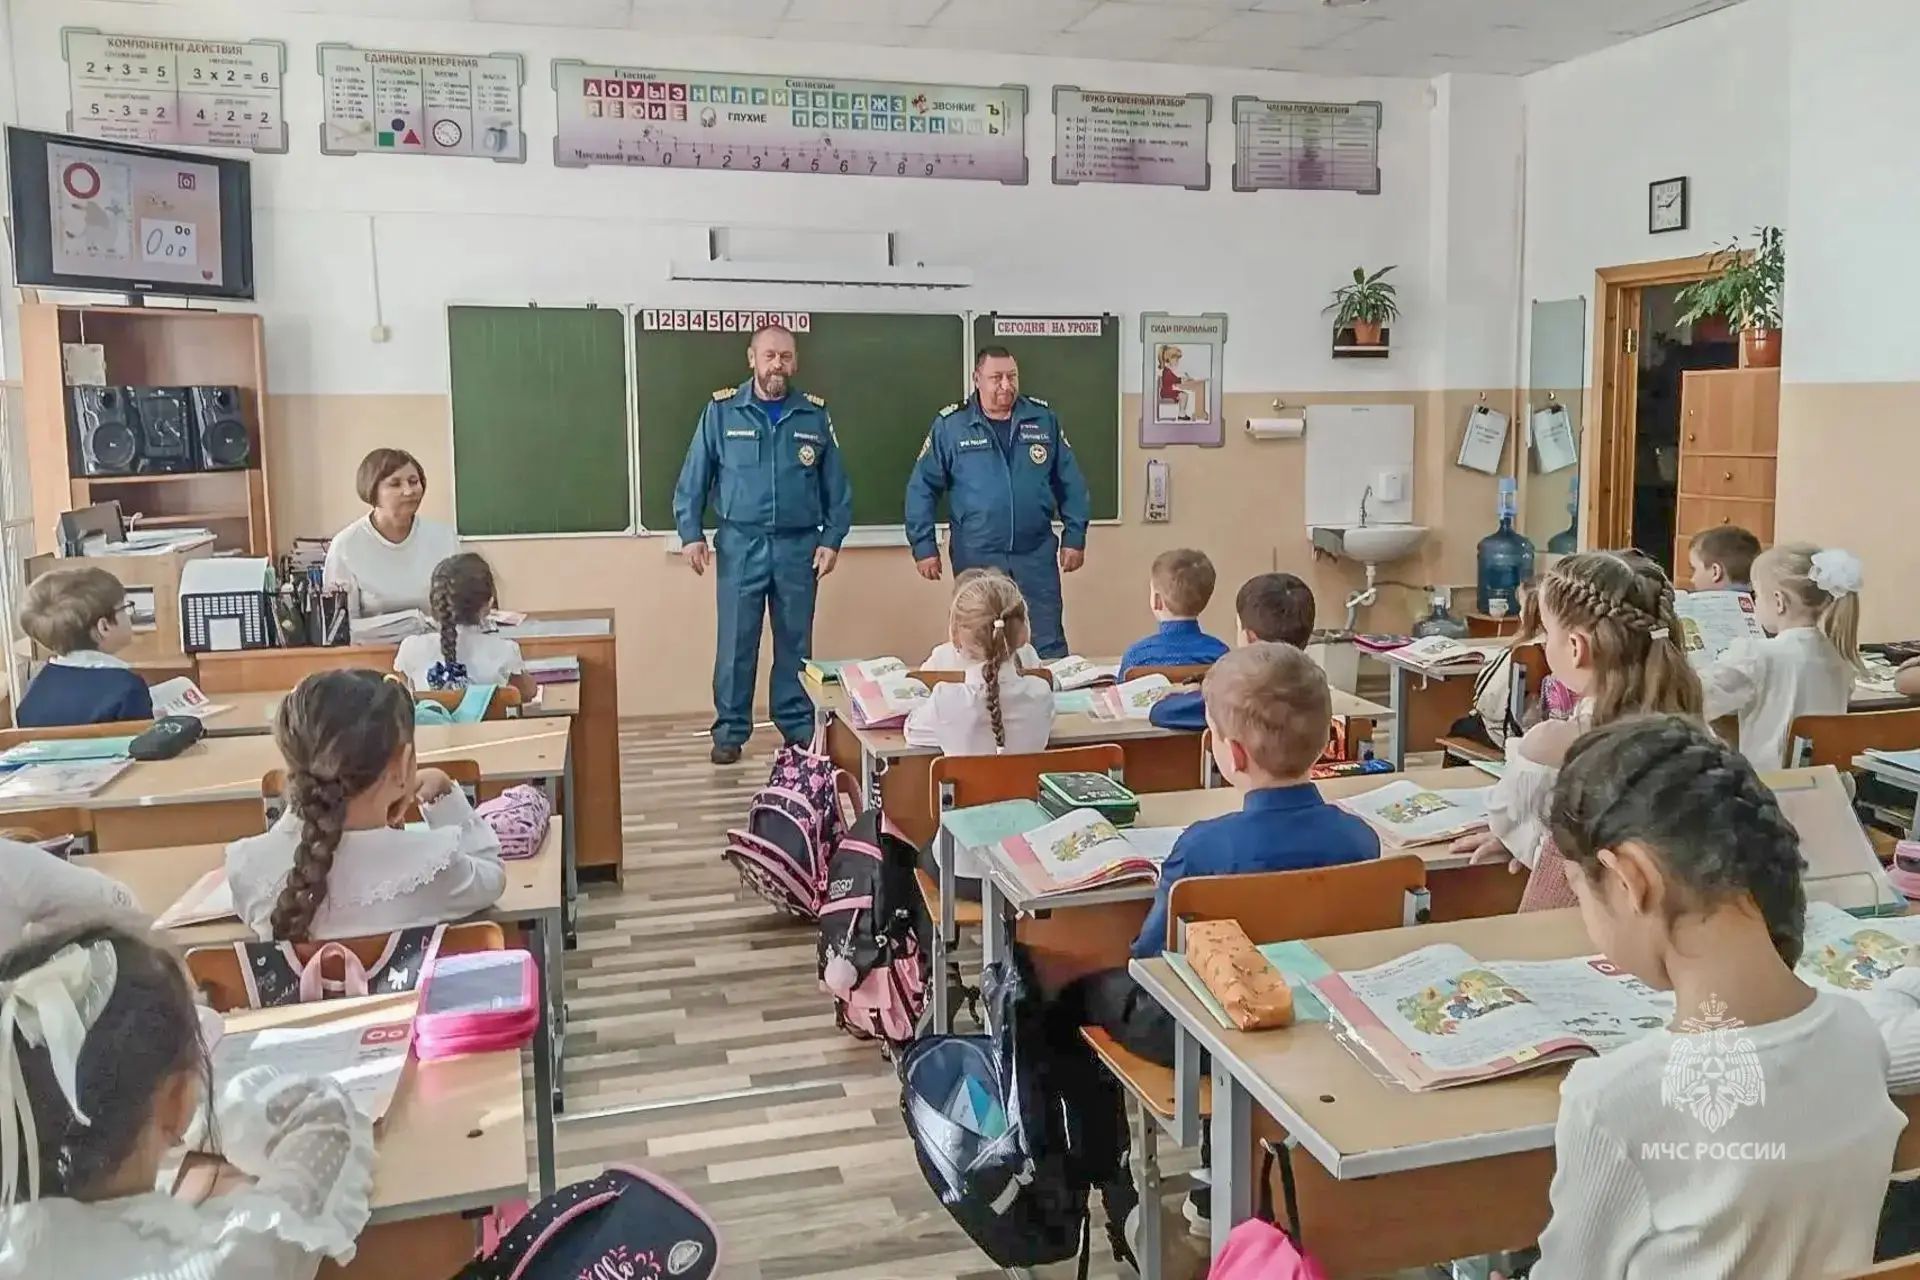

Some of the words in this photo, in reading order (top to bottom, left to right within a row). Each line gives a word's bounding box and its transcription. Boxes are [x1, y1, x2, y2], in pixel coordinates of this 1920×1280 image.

[106, 38, 185, 52] КОМПОНЕНТЫ
[364, 53, 418, 66] ЕДИНИЦЫ
[418, 56, 478, 68] ИЗМЕРЕНИЯ
[86, 62, 95, 73] 2
[122, 64, 131, 75] 3
[157, 66, 166, 77] 5
[193, 67, 202, 79] 3
[227, 70, 235, 81] 2
[261, 72, 269, 83] 6
[614, 69, 657, 80] Гласные
[91, 103, 100, 114] 5
[122, 105, 131, 116] 3
[156, 107, 165, 118] 2
[931, 101, 977, 112] ЗВОНКИЕ
[197, 108, 205, 120] 4
[227, 110, 235, 121] 2
[260, 112, 269, 123] 2
[728, 112, 768, 123] ГЛУХИЕ
[722, 154, 732, 168] 2
[752, 156, 761, 169] 3
[781, 157, 790, 170] 4
[811, 158, 820, 171] 5
[840, 160, 848, 173] 6
[869, 160, 878, 173] 7
[897, 161, 906, 175] 8
[925, 163, 934, 176] 9
[997, 322, 1046, 334] СЕГОДНЯ
[1051, 322, 1067, 333] НА
[1067, 322, 1099, 334] УРОКЕ
[1151, 324, 1172, 334] СИДИ
[1173, 324, 1218, 334] ПРАВИЛЬНО
